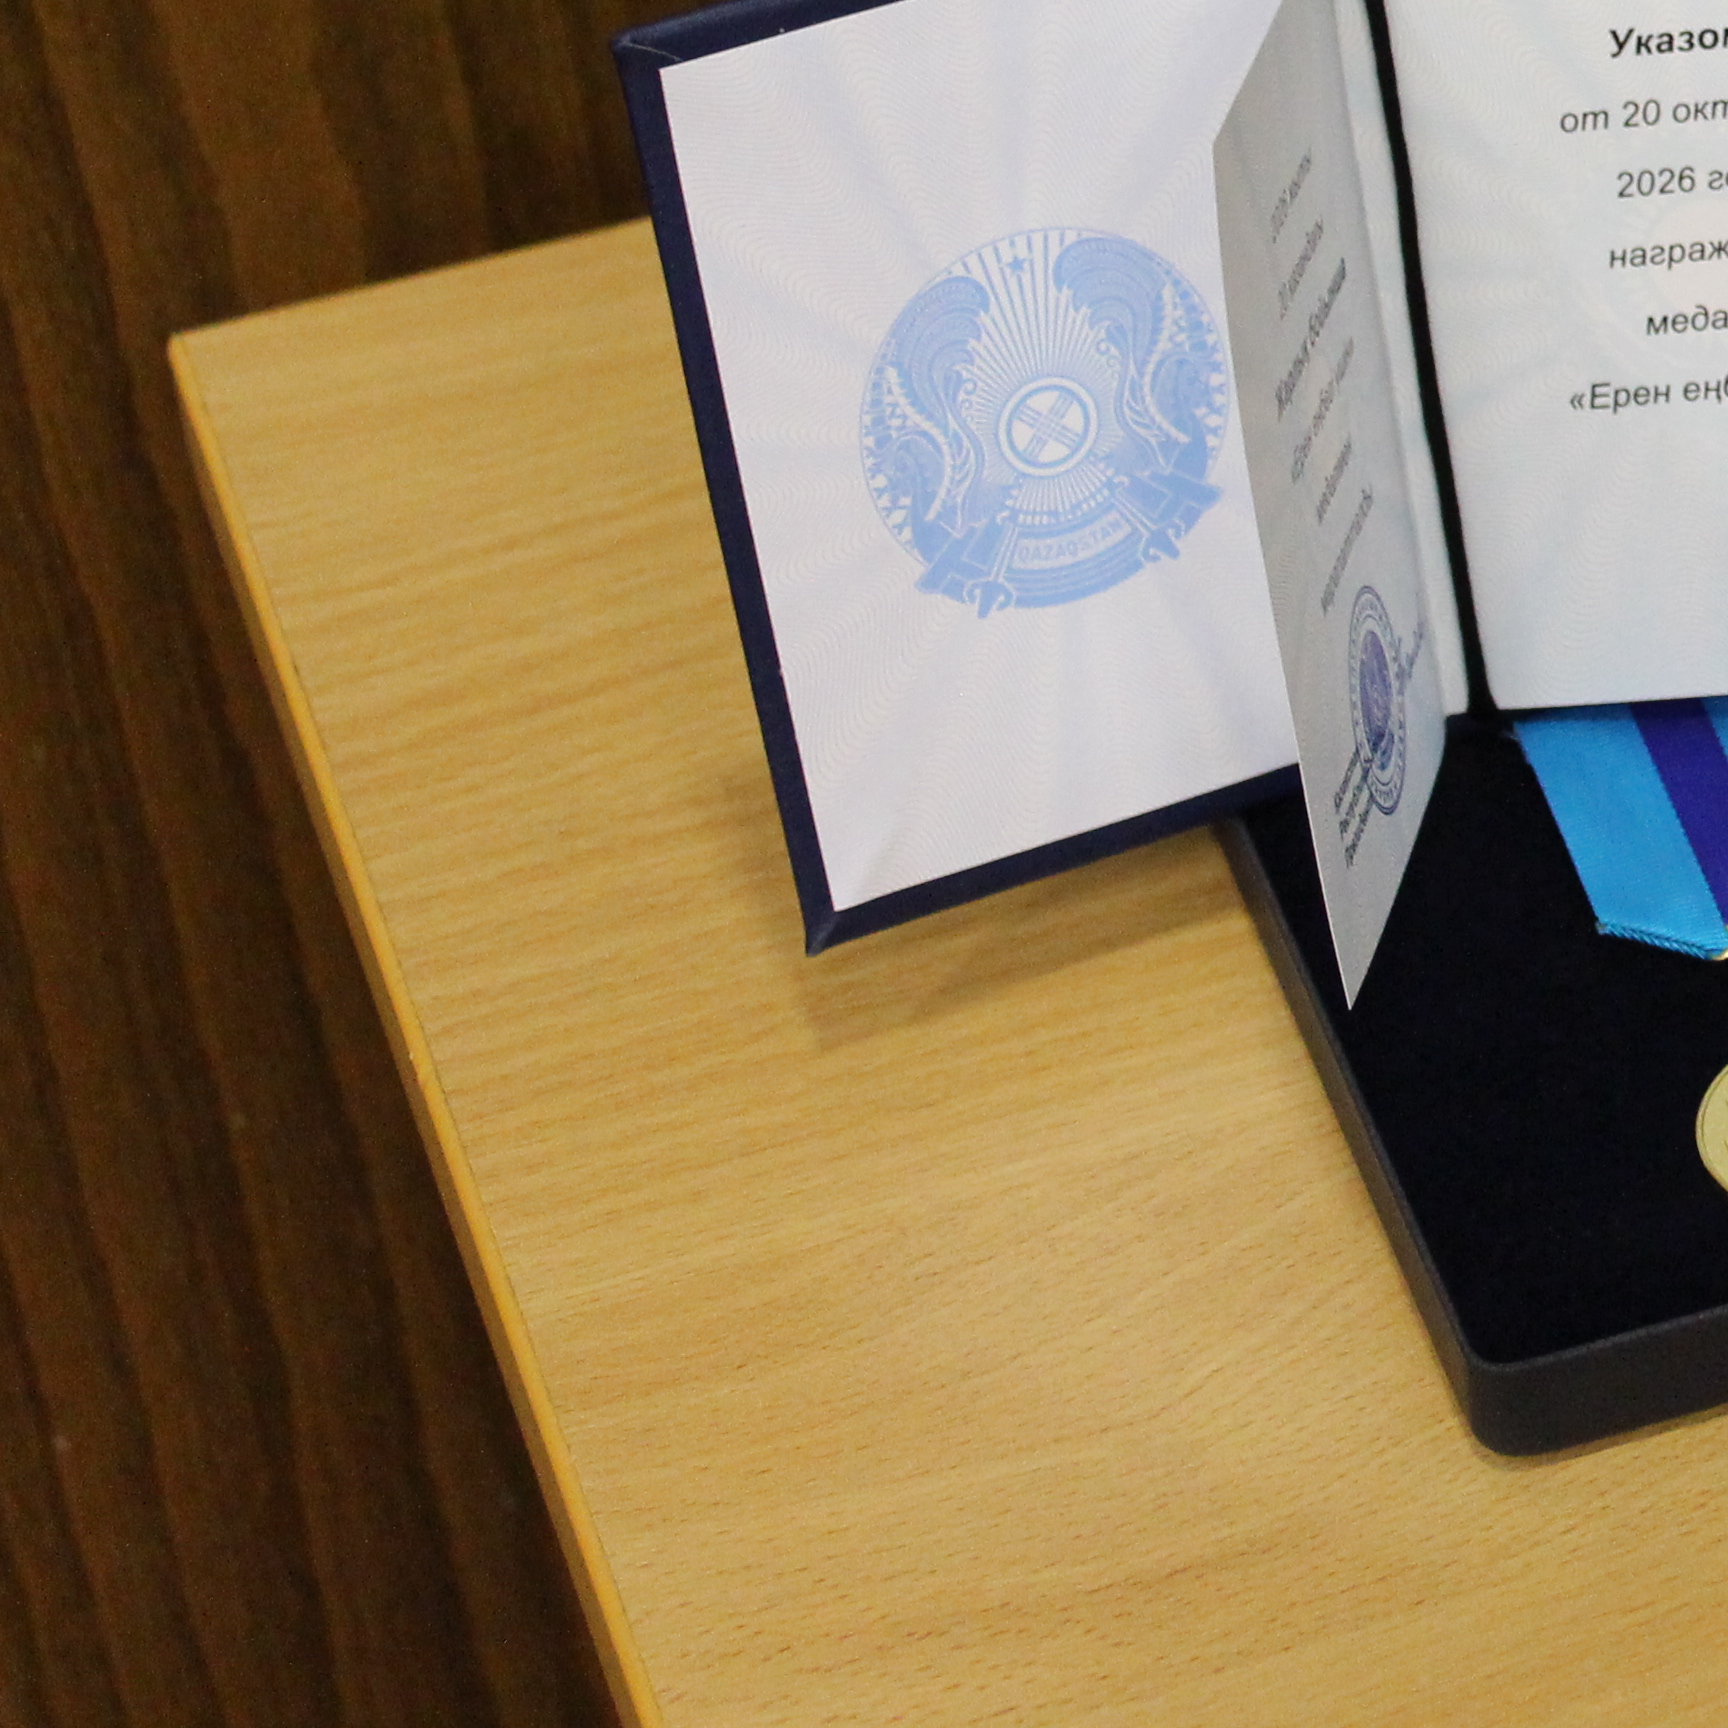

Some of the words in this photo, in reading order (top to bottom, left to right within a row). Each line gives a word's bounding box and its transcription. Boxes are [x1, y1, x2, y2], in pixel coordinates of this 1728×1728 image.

[1559, 108, 1610, 134] от
[1621, 98, 1663, 129] 20
[1616, 165, 1697, 200] 2026
[1568, 379, 1672, 415] «Ерен
